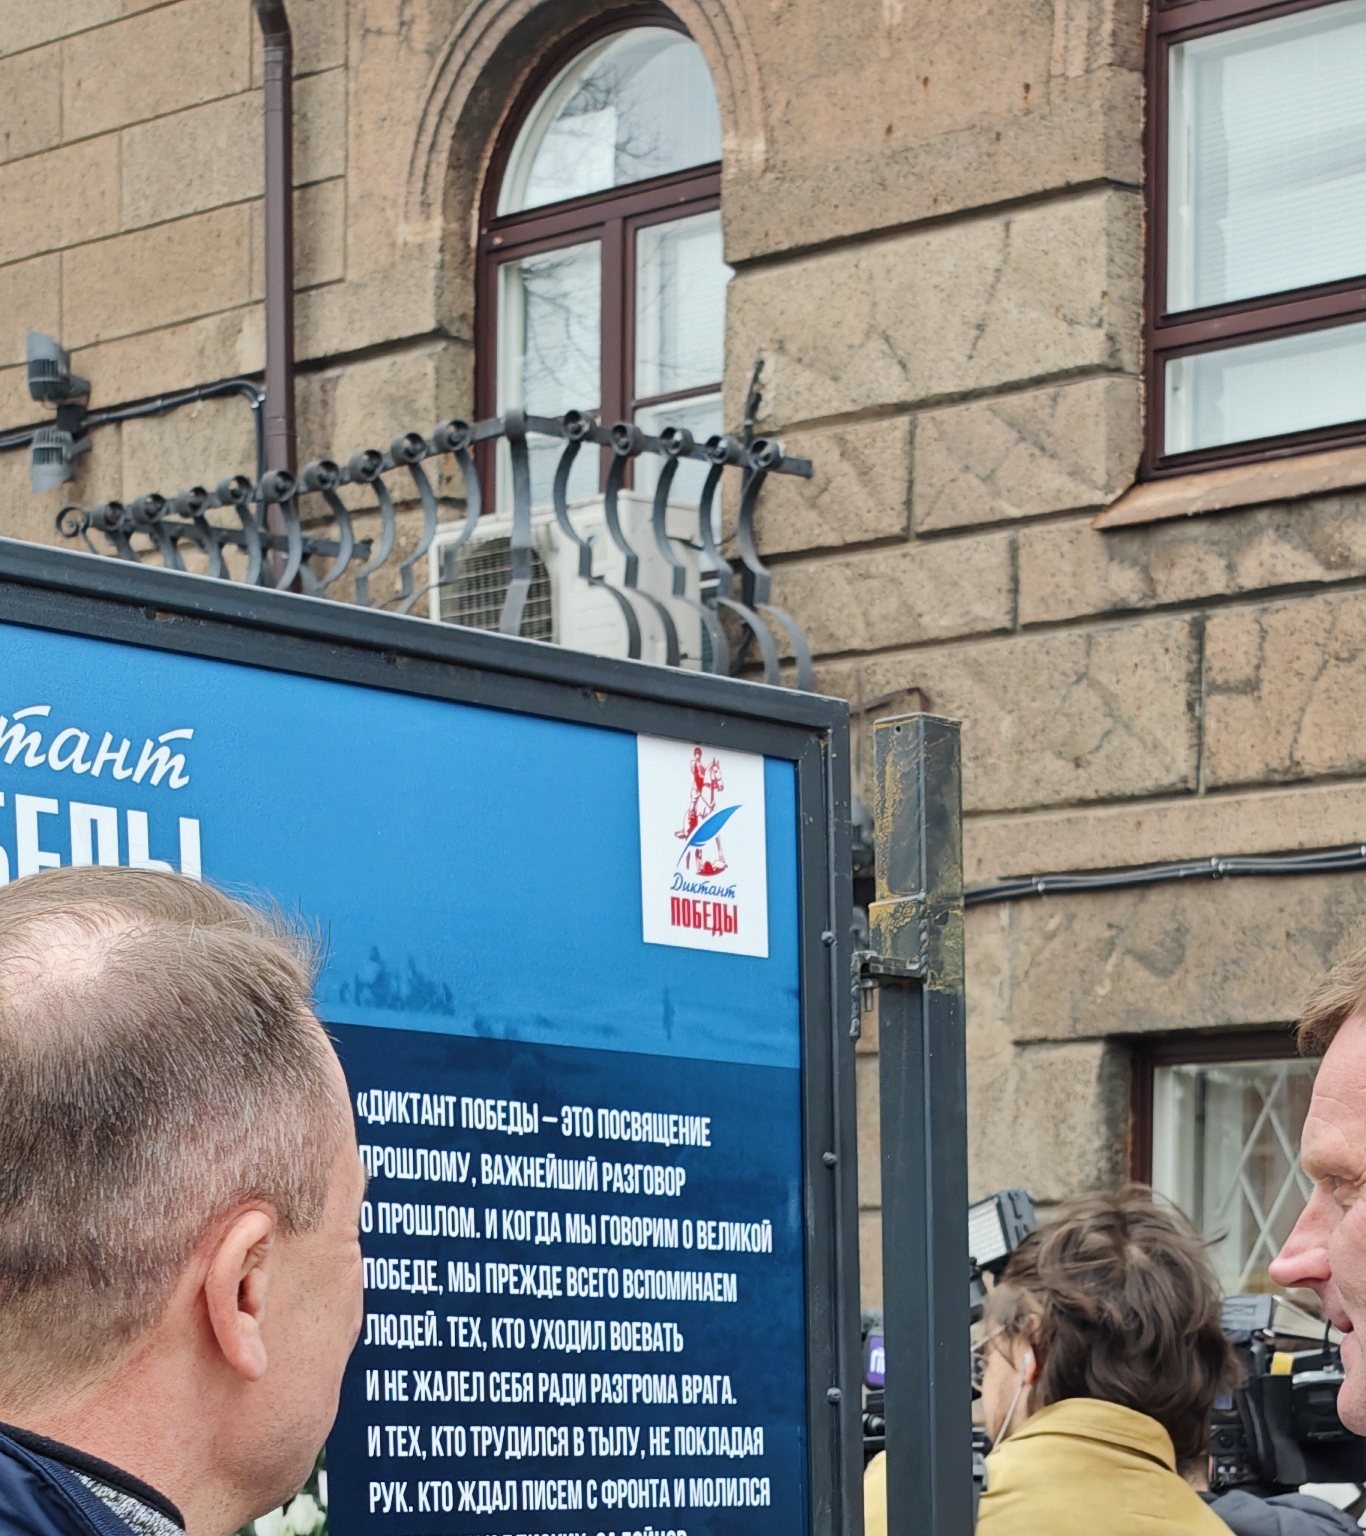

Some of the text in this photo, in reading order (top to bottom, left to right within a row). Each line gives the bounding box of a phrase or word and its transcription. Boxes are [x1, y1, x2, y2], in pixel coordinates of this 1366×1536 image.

[670, 872, 736, 899] Диктант
[670, 896, 738, 937] ПОБЕДЫ
[357, 1090, 456, 1127] «ДИКТАНТ
[461, 1097, 538, 1135] ПОБЕДЫ
[561, 1106, 593, 1137] ЭТО
[598, 1109, 711, 1146] ПОСВЯЩЕНИЕ
[481, 1153, 598, 1191] ВАЖНЕЙШИЙ
[602, 1162, 685, 1196] РАЗГОВОР
[361, 1201, 772, 1253] О ПРОШЛОМ. И КОГДА МЫ ГОВОРИМ О ВЕЛИКОЙ
[363, 1257, 737, 1302] ПОБЕДЕ, МЫ ПРЕЖДЕ ВСЕГО ВСПОМИНАЕМ
[364, 1311, 683, 1353] ЛЮДЕЙ. ТЕХ, КТО УХОДИЛ ВОЕВАТЬ
[367, 1370, 736, 1406] И НЕ ЖАЛЕЛ СЕБЯ РАДИ РАЗГРОМА ВРАГА.
[368, 1426, 763, 1460] И ТЕХ, КТО ТРУДИЛСЯ В ТЫЛУ, НЕ ПОКЛАДАЯ
[370, 1478, 770, 1514] РУК. КТО ЖДАЛ ПИСЕМ С ФРОНТА И МОЛИЛСЯ
